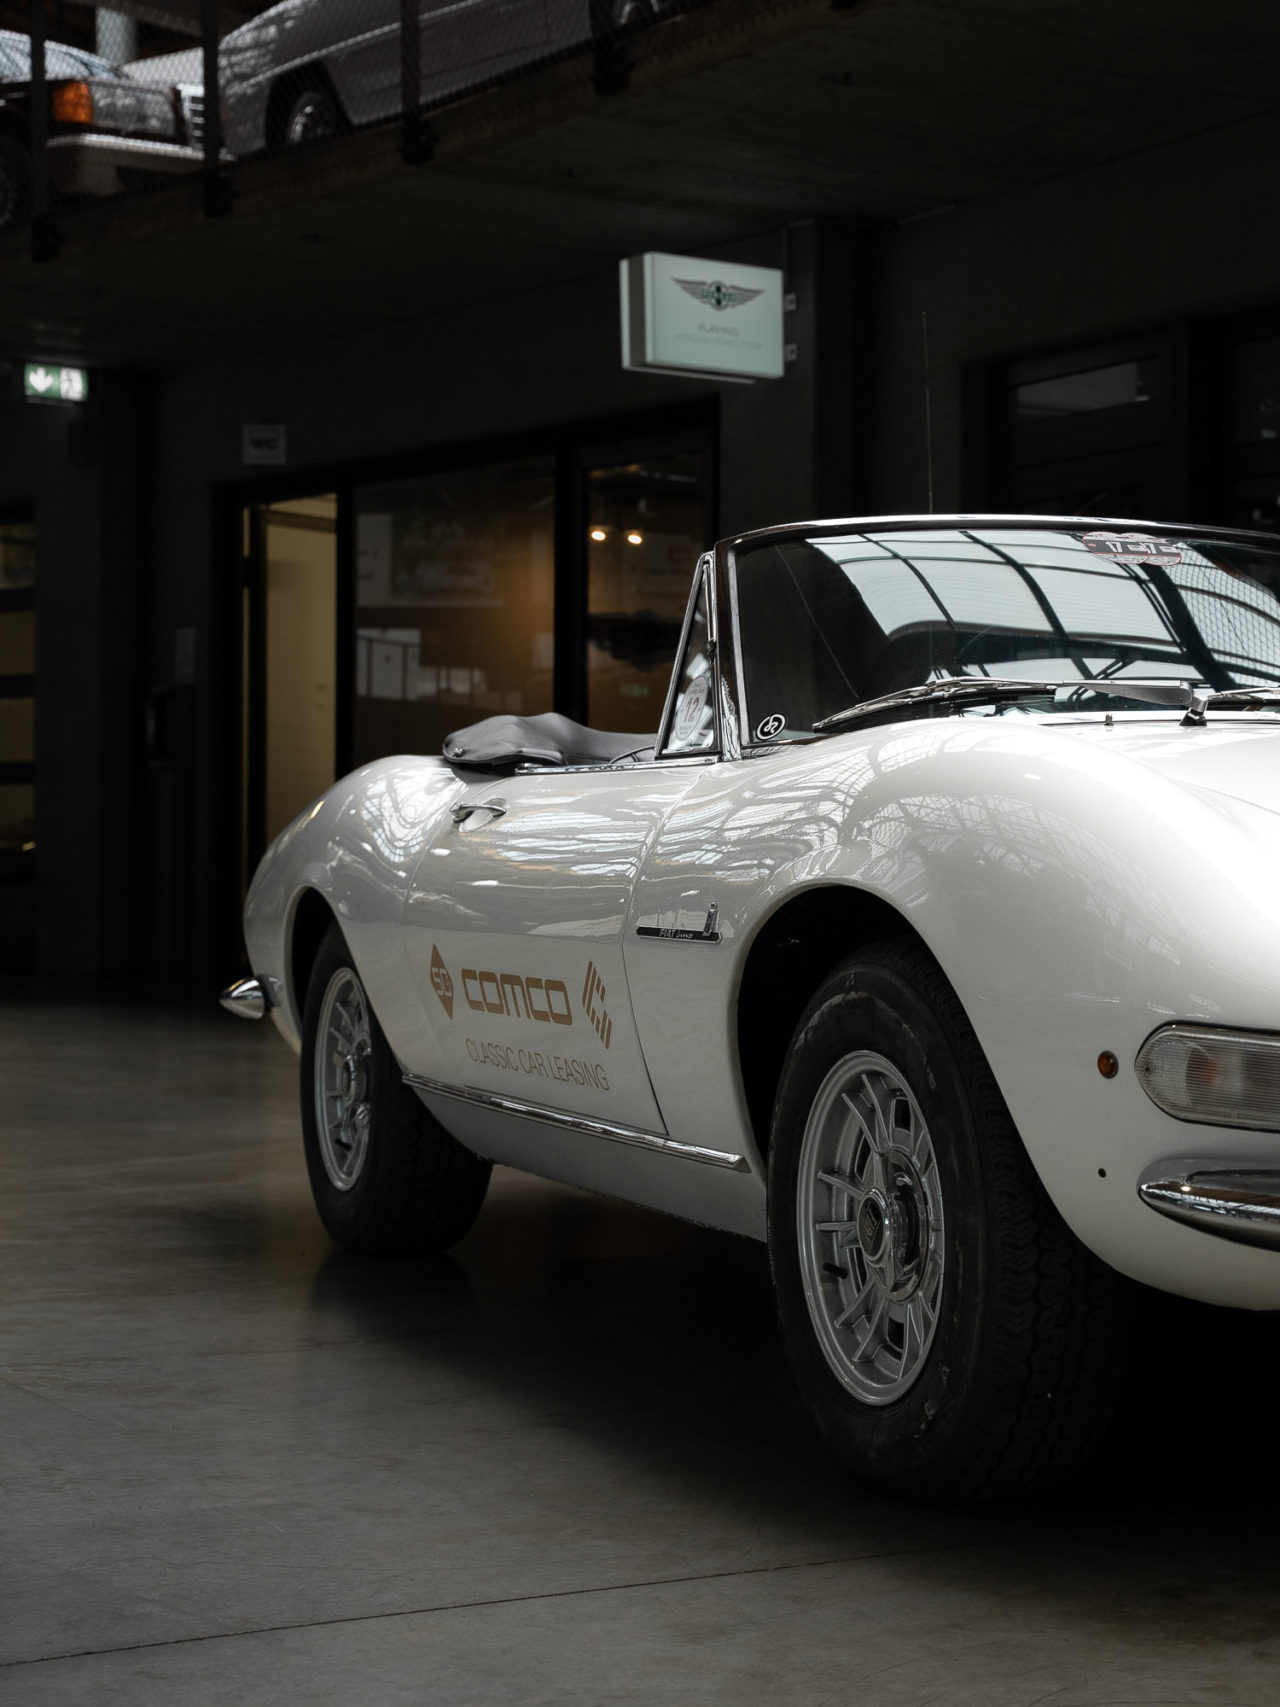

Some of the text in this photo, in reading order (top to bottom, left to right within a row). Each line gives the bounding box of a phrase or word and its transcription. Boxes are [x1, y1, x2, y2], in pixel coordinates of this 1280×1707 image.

[465, 1037, 611, 1091] CLASSIC CAR LEASING
